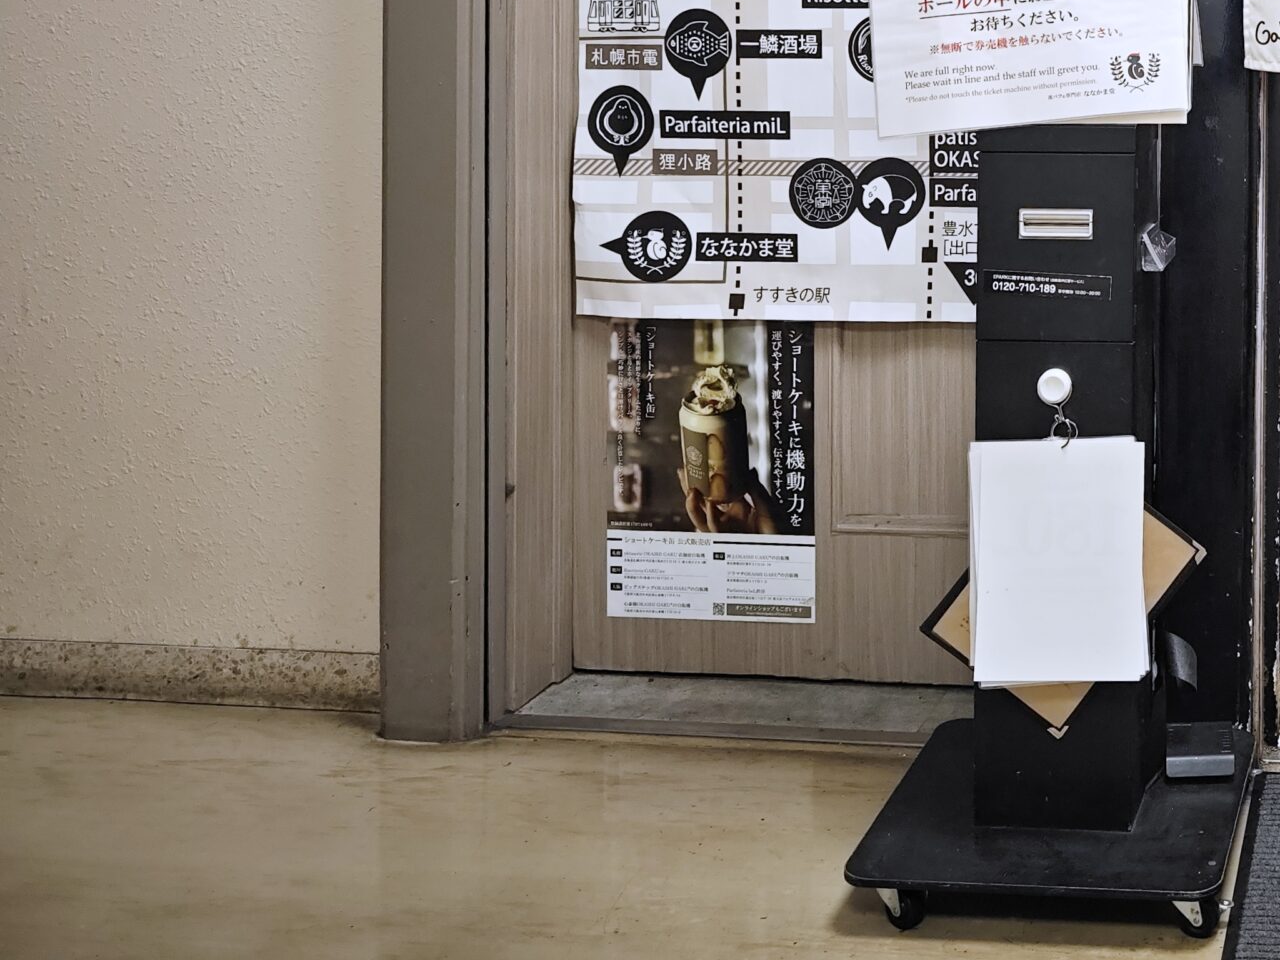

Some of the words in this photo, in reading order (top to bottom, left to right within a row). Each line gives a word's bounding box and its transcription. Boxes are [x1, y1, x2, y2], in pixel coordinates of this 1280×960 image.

[970, 9, 1080, 32] お待ちください。
[740, 35, 818, 55] 一鱗酒場
[929, 27, 1125, 56] ※無断で券売機を触らないでください。
[591, 48, 659, 67] 札幌市電
[904, 70, 919, 79] We
[920, 70, 933, 78] are
[934, 67, 950, 76] full
[951, 64, 974, 76] right
[904, 80, 931, 90] Please
[932, 78, 952, 87] wait
[964, 75, 982, 84] line
[983, 73, 1000, 82] and
[1002, 71, 1016, 80] the
[1017, 69, 1037, 79] staff
[1038, 67, 1055, 76] will
[1056, 65, 1079, 77] greet
[951, 91, 970, 99] touch
[984, 88, 1003, 96] ticket
[1004, 85, 1032, 94] machine
[1032, 82, 1058, 91] without
[664, 115, 751, 134] Parfaiteria
[753, 117, 786, 134] miL
[659, 153, 713, 172] 狸小路
[934, 184, 977, 202] Parfa
[942, 220, 978, 238] 豊水
[700, 238, 794, 258] ななかま堂
[752, 286, 831, 304] すすきの駅
[992, 281, 1056, 294] 0120-710-189
[645, 326, 657, 419] 「ショートケーキ缶」
[771, 330, 784, 505] 運びやすく。渡しやすく。伝えやすく。
[785, 329, 806, 527] ショートケーキに機動力を
